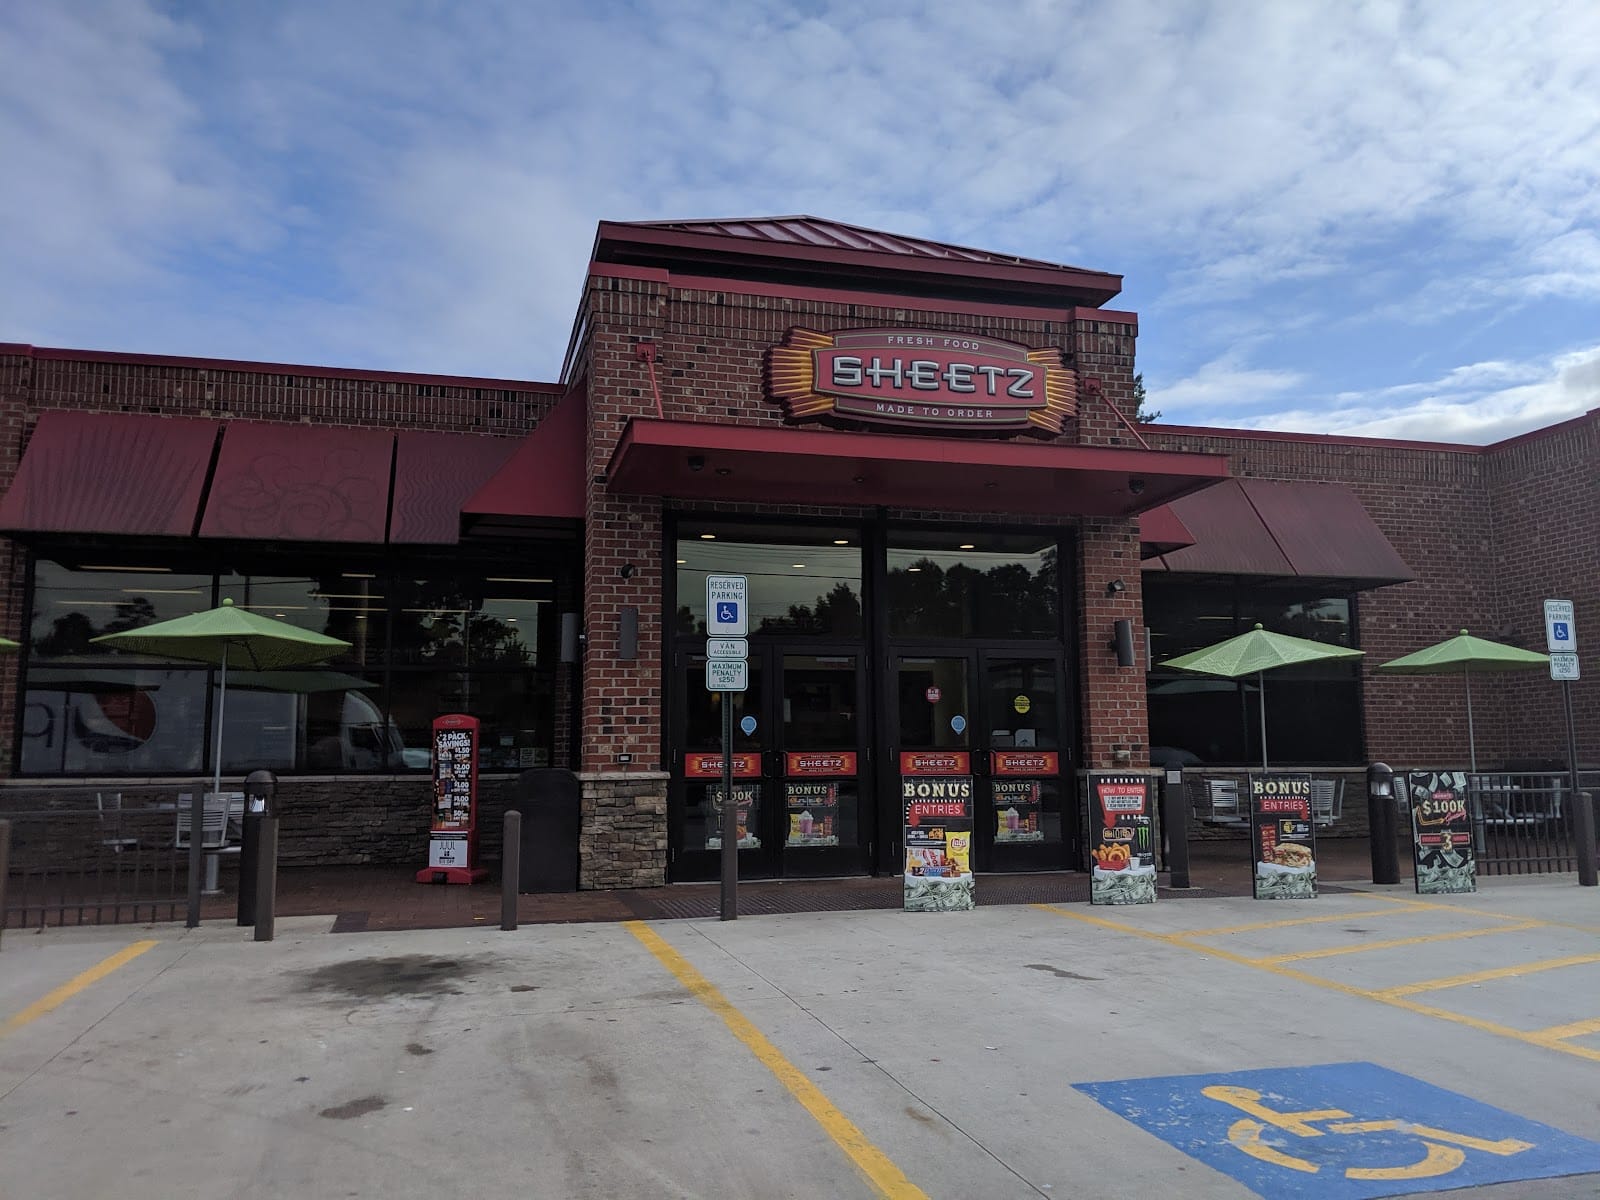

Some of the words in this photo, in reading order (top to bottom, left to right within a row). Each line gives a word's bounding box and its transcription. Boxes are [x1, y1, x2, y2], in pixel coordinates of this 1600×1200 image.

[887, 335, 934, 346] FRESH
[944, 338, 980, 350] FOOD
[832, 356, 1035, 398] SHEETZ
[876, 403, 915, 415] MADE
[923, 406, 940, 416] TO
[947, 408, 994, 419] ORDER
[710, 581, 744, 590] RESERVED
[711, 591, 743, 600] PARKING
[1547, 605, 1571, 613] RESERVED
[719, 642, 735, 650] VAN
[712, 669, 742, 677] PENALTY
[442, 733, 447, 741] 2
[447, 732, 466, 741] PACK
[438, 739, 471, 748] SAVINGS!
[701, 761, 745, 769] SHETZ
[799, 759, 842, 767] SHEETZ
[915, 759, 956, 767] SHEETZ
[787, 785, 828, 795] BONUS
[904, 782, 970, 798] BONUS
[995, 783, 1031, 793] BONUS
[1101, 786, 1115, 794] HOW
[1118, 786, 1126, 794] TO
[1253, 781, 1310, 795] BONUS
[915, 804, 961, 815] ENTRIES
[1263, 801, 1304, 810] ENTRIES
[1422, 799, 1465, 816] $100K
